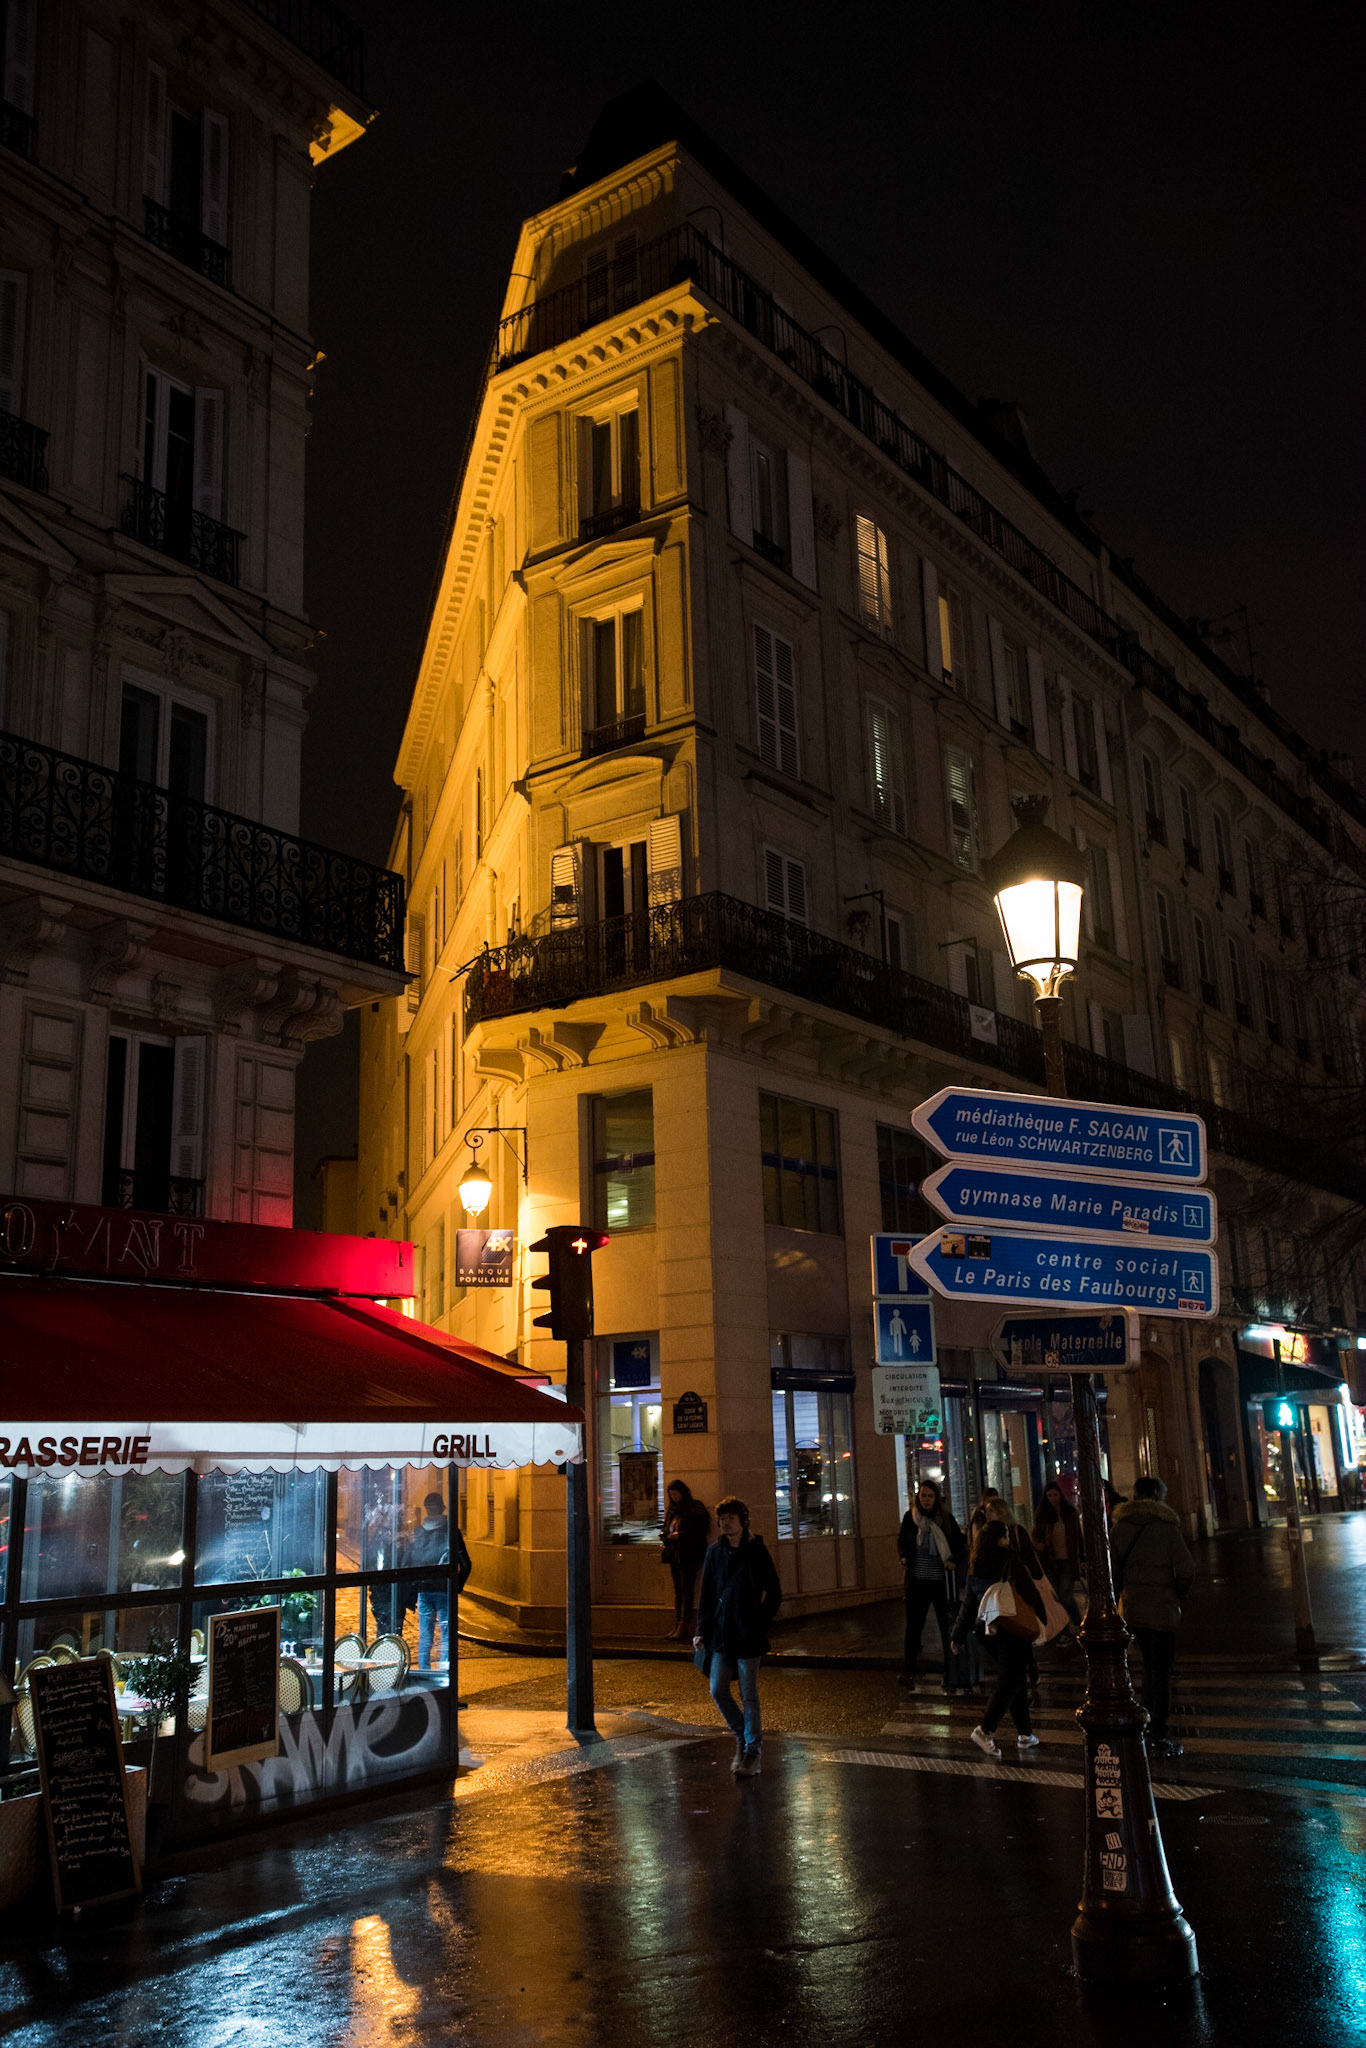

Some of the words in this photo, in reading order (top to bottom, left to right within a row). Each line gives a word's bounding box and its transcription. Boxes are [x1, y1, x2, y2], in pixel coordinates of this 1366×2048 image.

[956, 1107, 1064, 1134] médiathèque
[1069, 1118, 1082, 1135] F.
[1088, 1120, 1149, 1142] SAGAN
[956, 1131, 979, 1144] rue
[982, 1132, 1014, 1147] Léon
[1018, 1135, 1153, 1162] SCHWARTZENBERG
[960, 1187, 1042, 1209] gymnase
[1050, 1197, 1103, 1215] Marie
[1111, 1200, 1178, 1223] Paradis
[459, 1268, 510, 1276] BANQUE
[1036, 1252, 1102, 1270] centre
[1115, 1259, 1178, 1277] social
[459, 1276, 510, 1284] POPULAIRE
[955, 1266, 975, 1285] Le
[983, 1269, 1031, 1289] Paris
[1040, 1273, 1071, 1292] des
[1079, 1277, 1177, 1303] Faubourgs
[1050, 1332, 1123, 1352] Maternelle
[433, 1434, 496, 1459] GRILL
[233, 1623, 258, 1633] MARTINI
